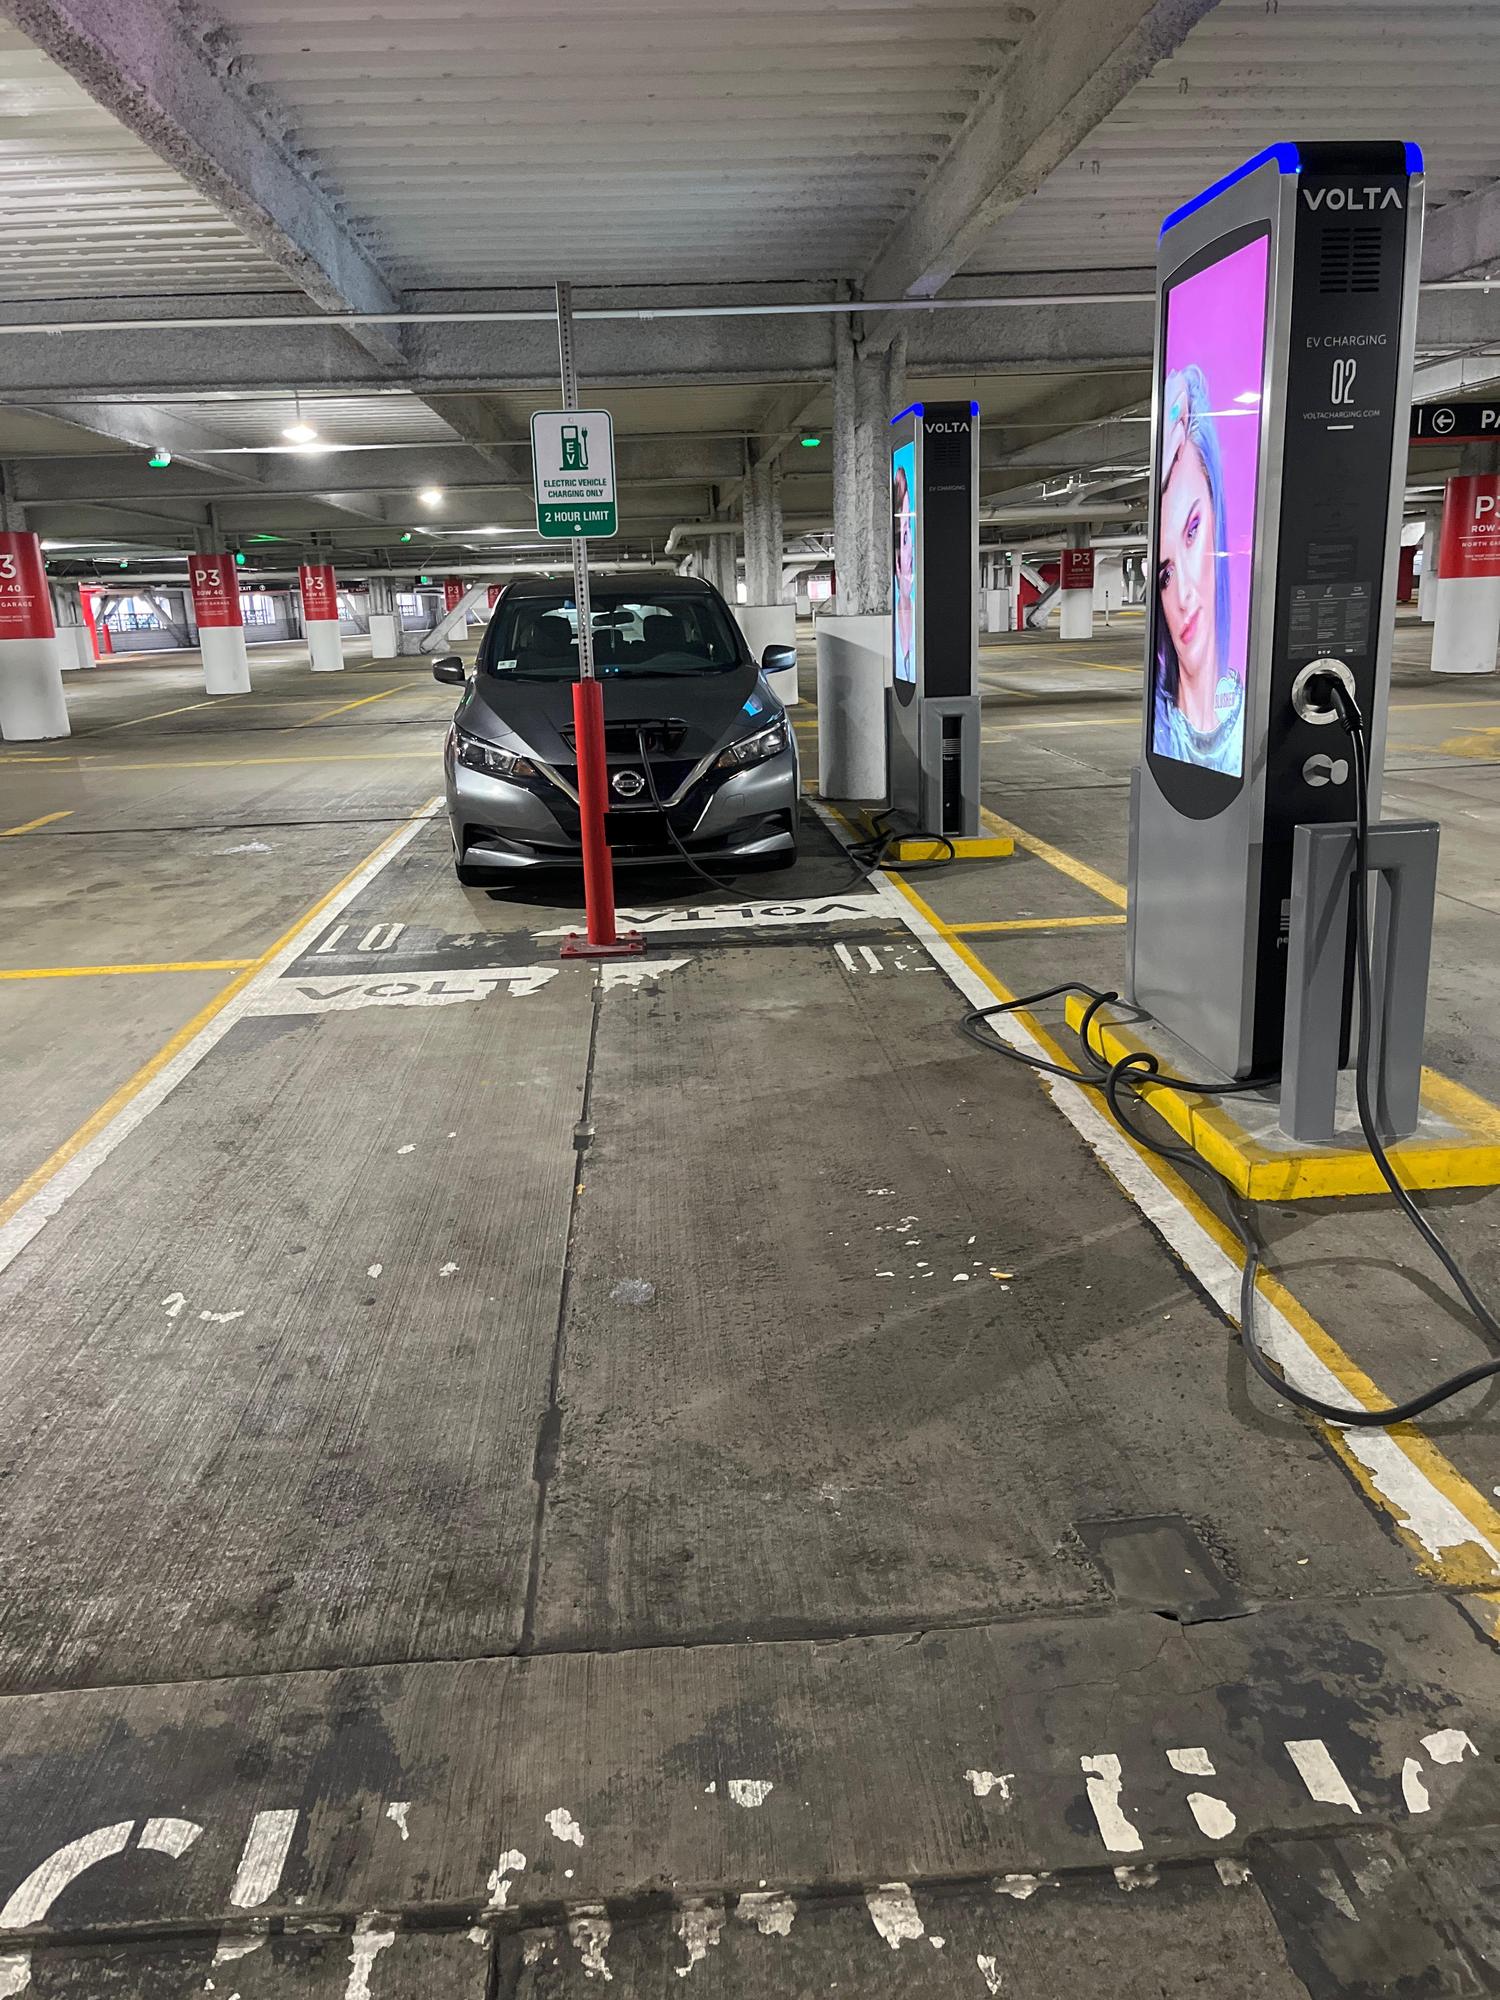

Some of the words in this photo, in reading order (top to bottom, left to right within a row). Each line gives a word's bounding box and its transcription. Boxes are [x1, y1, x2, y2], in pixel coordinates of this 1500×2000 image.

[1302, 187, 1403, 211] VOLTA
[1306, 337, 1320, 348] EV
[1324, 334, 1387, 347] CHARGING
[1331, 358, 1356, 404] 02
[925, 422, 970, 433] VOLTA
[543, 479, 577, 487] ELECTRIC
[578, 478, 607, 486] VEHICLE
[548, 490, 584, 498] CHARGING
[586, 489, 604, 497] ONLY
[545, 512, 552, 523] 2
[554, 511, 581, 522] HOUR
[583, 510, 609, 521] LIMIT
[1471, 525, 1495, 533] ROW
[1072, 553, 1090, 565] P3
[195, 569, 220, 587] P3
[305, 577, 324, 590] P3
[7, 584, 21, 593] 40
